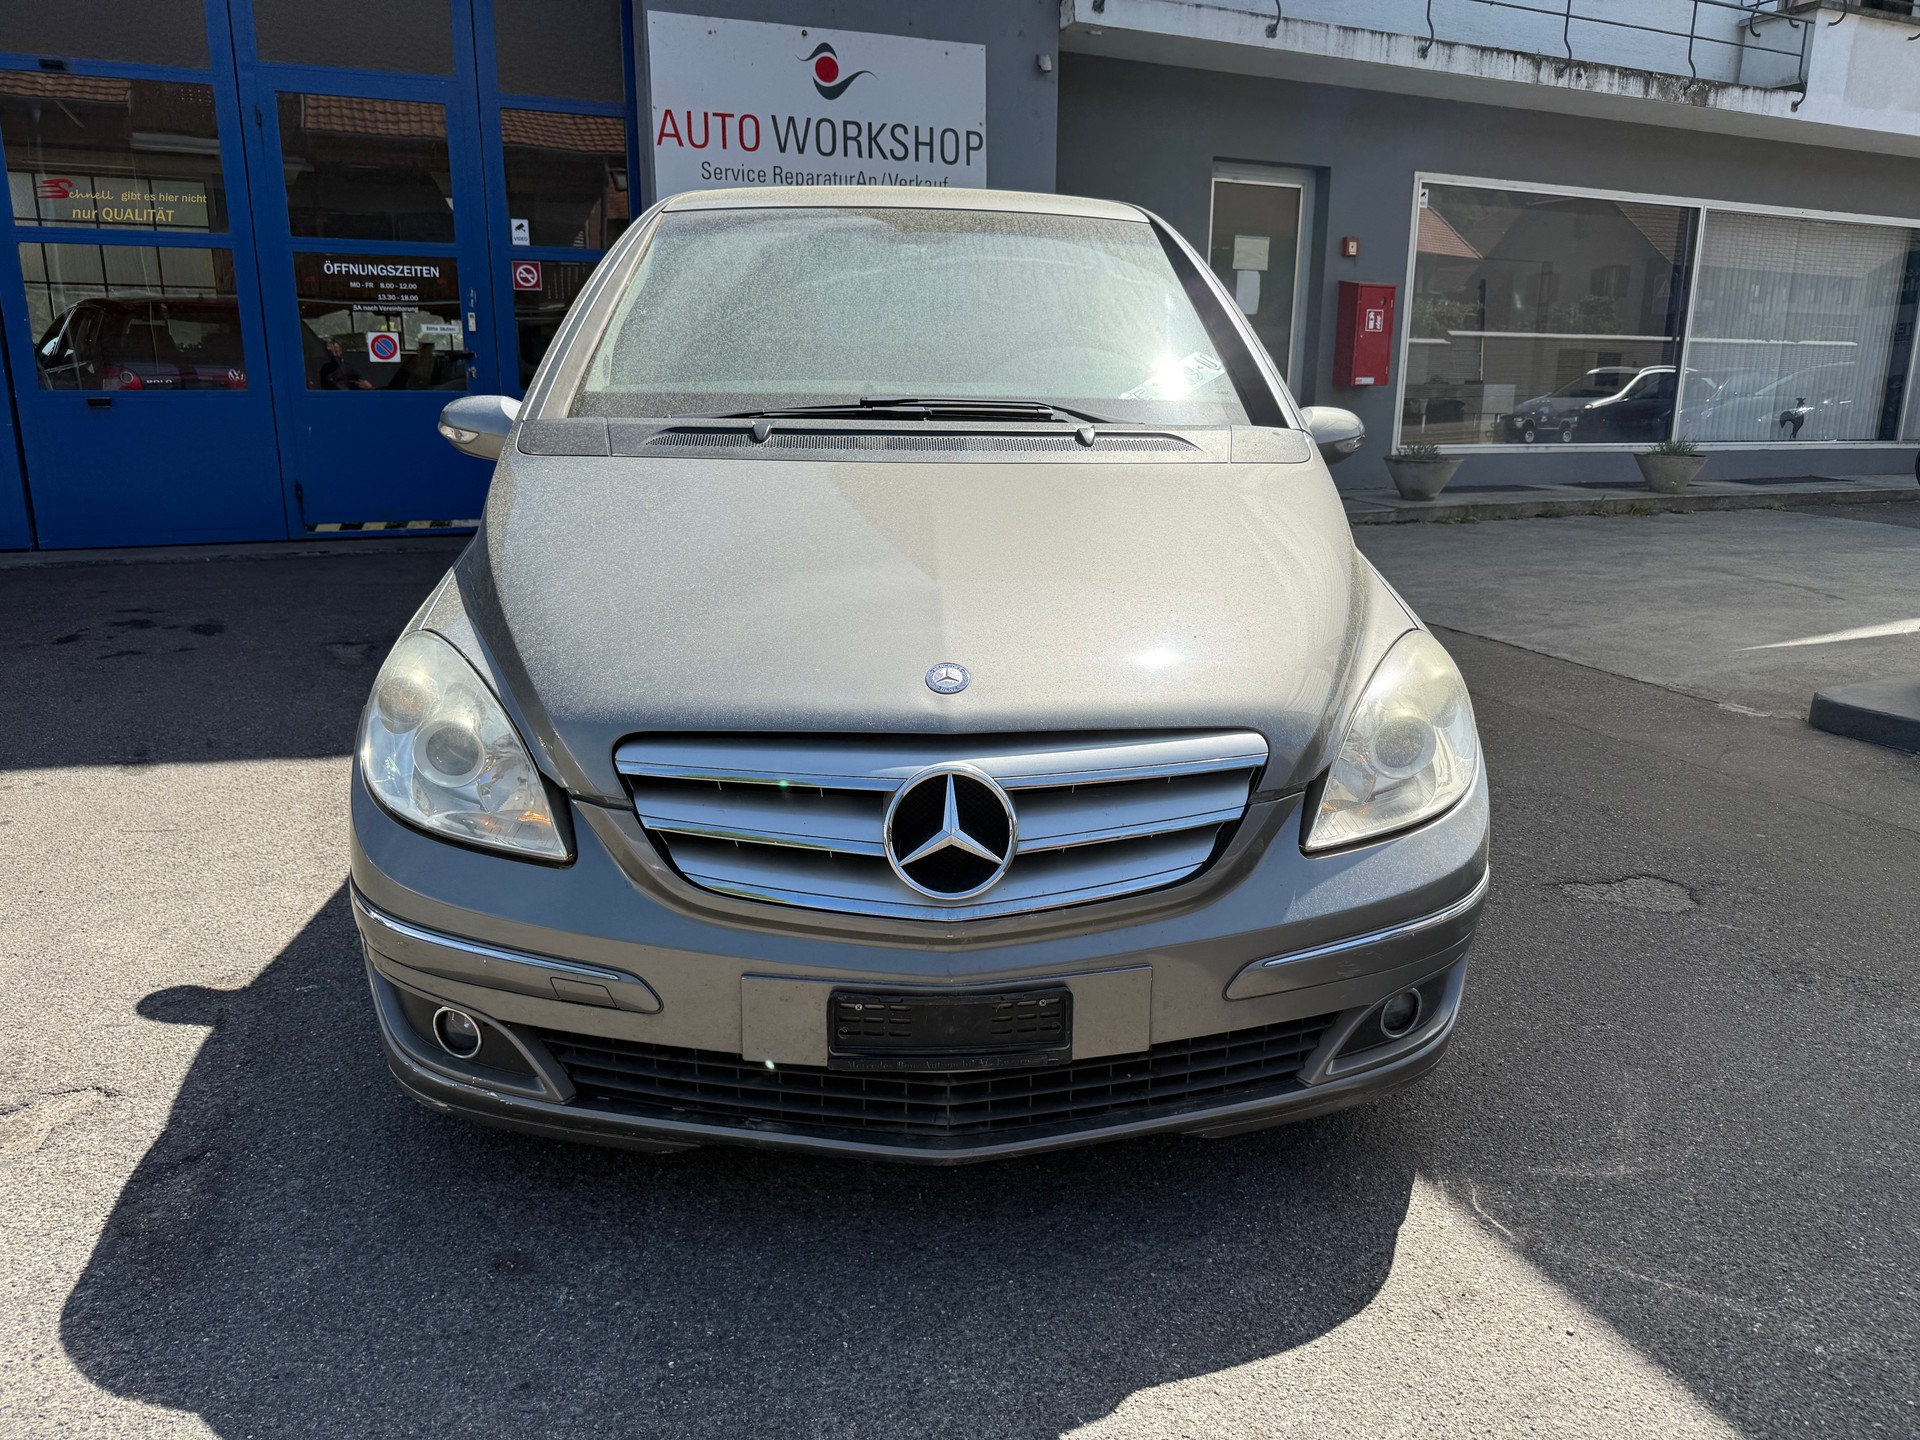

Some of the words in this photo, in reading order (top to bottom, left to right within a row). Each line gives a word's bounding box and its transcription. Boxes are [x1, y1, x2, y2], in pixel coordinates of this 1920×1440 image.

[656, 109, 761, 152] AUTO
[771, 114, 984, 166] WORKSHOP
[701, 161, 767, 183] Service
[36, 178, 114, 200] Schnell
[121, 191, 141, 202] gibt
[144, 193, 156, 202] es
[159, 192, 179, 202] hier
[181, 193, 207, 203] nicht
[72, 208, 98, 219] nur
[102, 206, 175, 222] QUALITÄT
[323, 260, 440, 278] ÖFFNUNGSZEITEN
[379, 305, 419, 313] Vereinbarung
